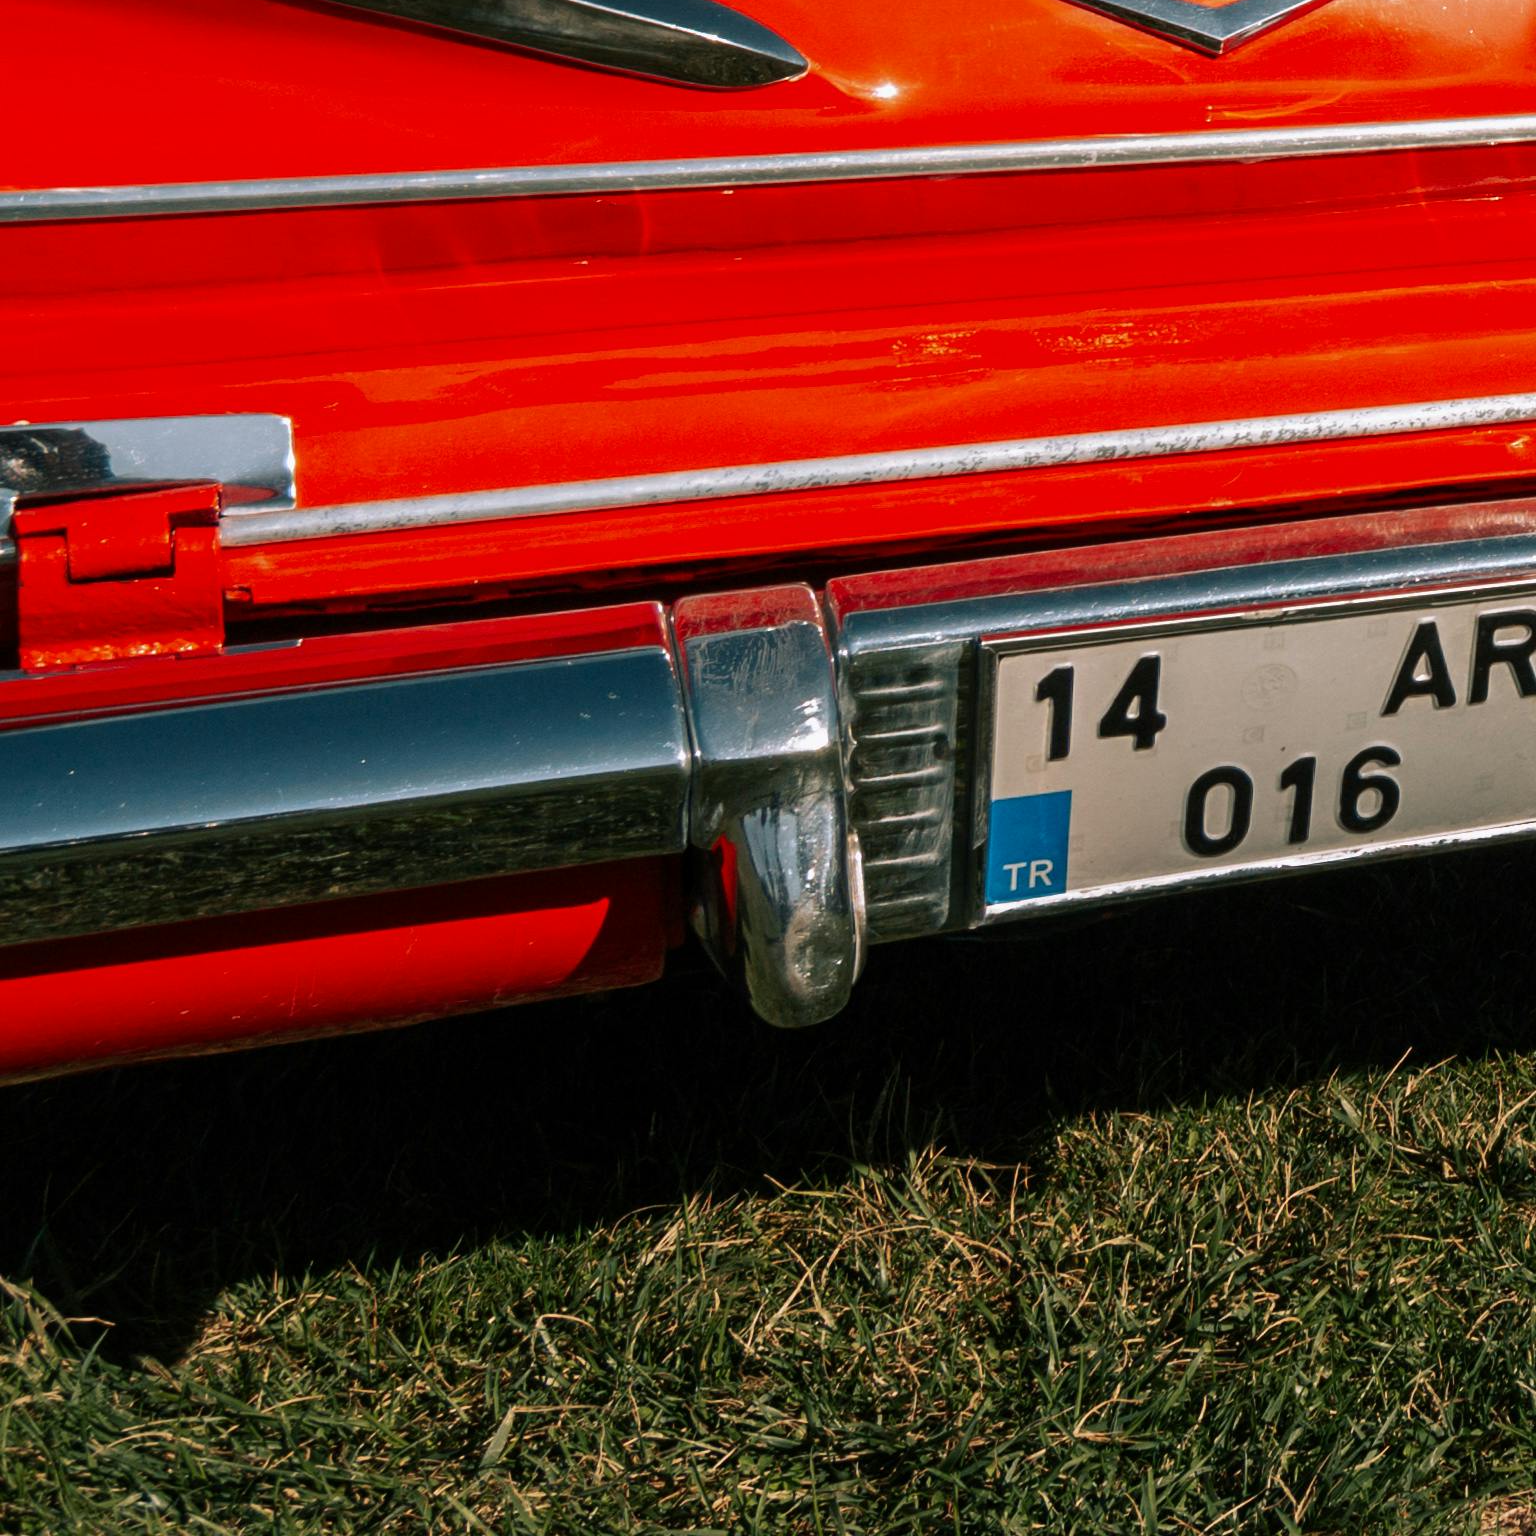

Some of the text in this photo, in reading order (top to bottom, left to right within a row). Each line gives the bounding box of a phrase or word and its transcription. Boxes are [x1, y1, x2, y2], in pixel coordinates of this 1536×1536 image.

[1035, 652, 1166, 762] 14
[1182, 745, 1402, 857] 016
[1003, 859, 1054, 892] TR
